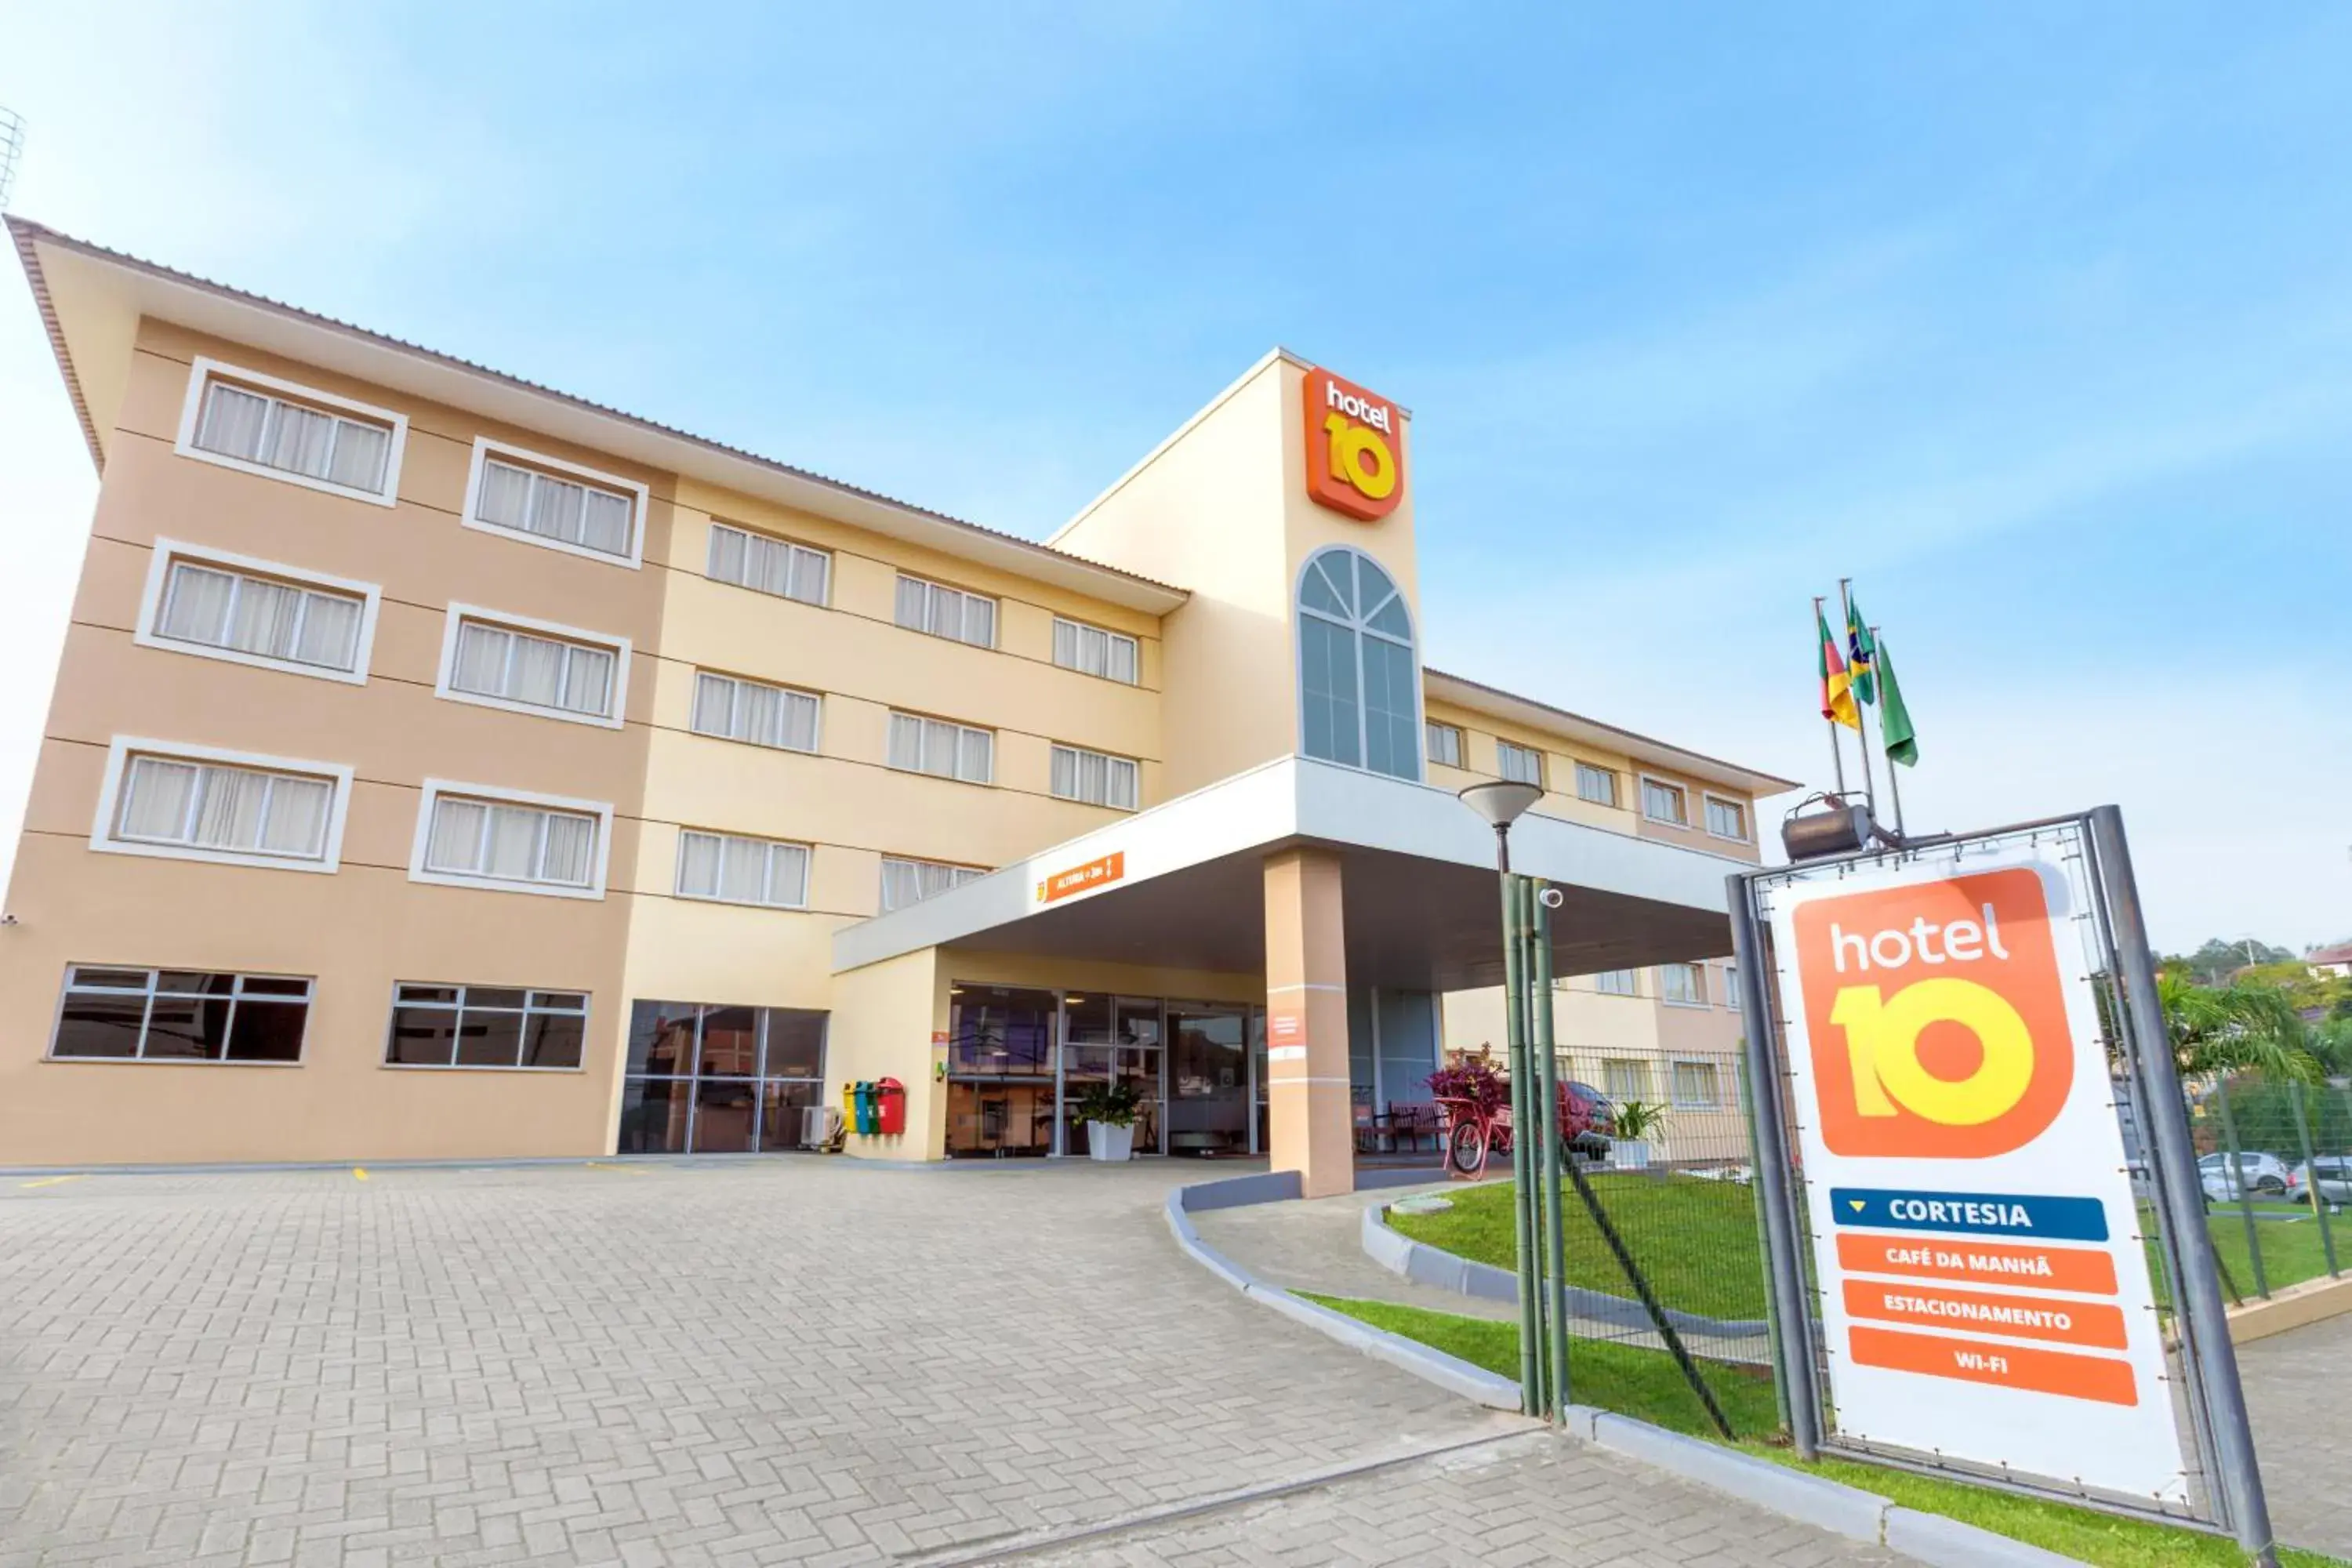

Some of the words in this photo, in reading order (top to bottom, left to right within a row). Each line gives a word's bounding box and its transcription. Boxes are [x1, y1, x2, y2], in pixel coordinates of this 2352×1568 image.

[1327, 380, 1391, 434] hotel
[1323, 410, 1396, 499] 10
[1830, 902, 2009, 973] hotel
[1829, 977, 2034, 1126] 10
[1889, 1198, 2032, 1228] CORTESIA
[1886, 1247, 1932, 1266] CAFÉ
[1936, 1252, 1964, 1270] DA
[1969, 1255, 2053, 1276] MANHÃ
[1884, 1294, 2071, 1330] ESTACIONAMENTO
[1954, 1351, 2008, 1374] WI-FI
